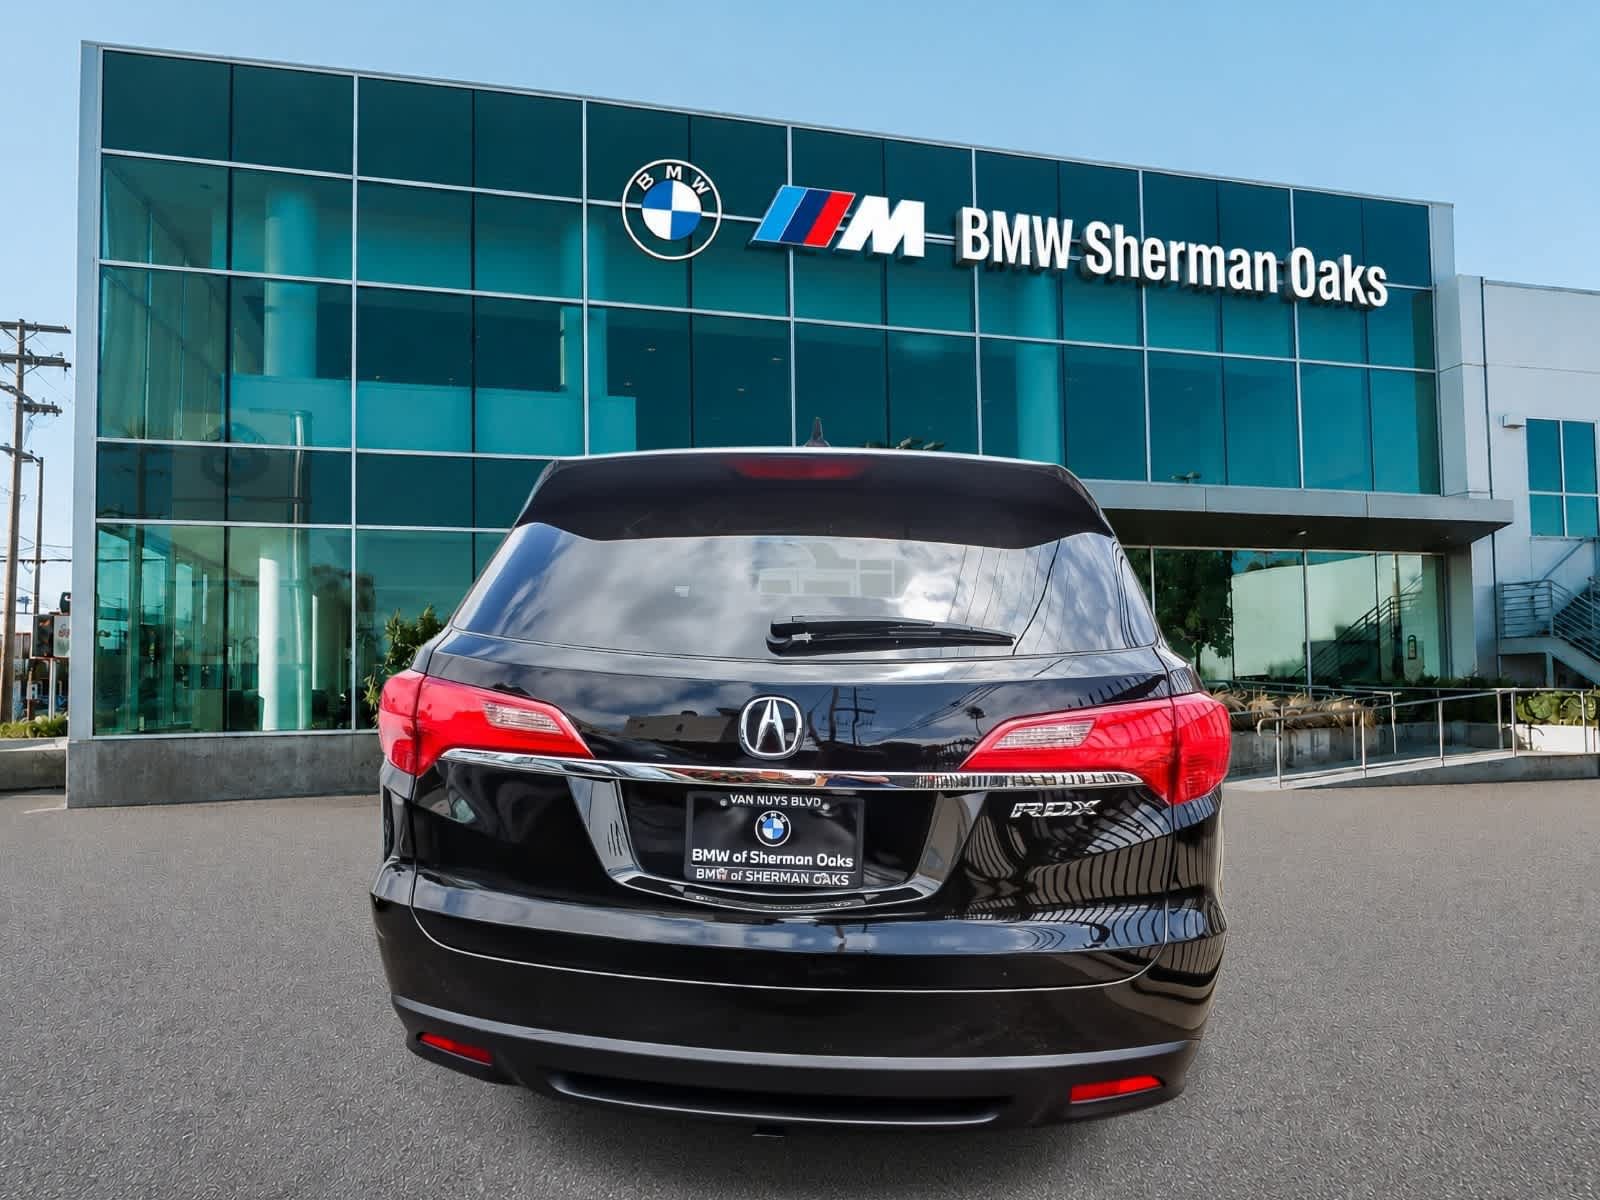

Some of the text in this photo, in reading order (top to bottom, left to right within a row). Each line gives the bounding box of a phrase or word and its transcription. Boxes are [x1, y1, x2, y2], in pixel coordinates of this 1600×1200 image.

[636, 165, 711, 195] BMW
[834, 194, 925, 258] M
[961, 206, 1389, 308] BMW Sherman Oaks
[729, 794, 821, 808] VAN NUYS BLVD
[1009, 800, 1102, 818] RDX
[692, 848, 854, 868] BMW of Sherman Oaks
[696, 868, 849, 886] BMW of SHERMAN OAKS
